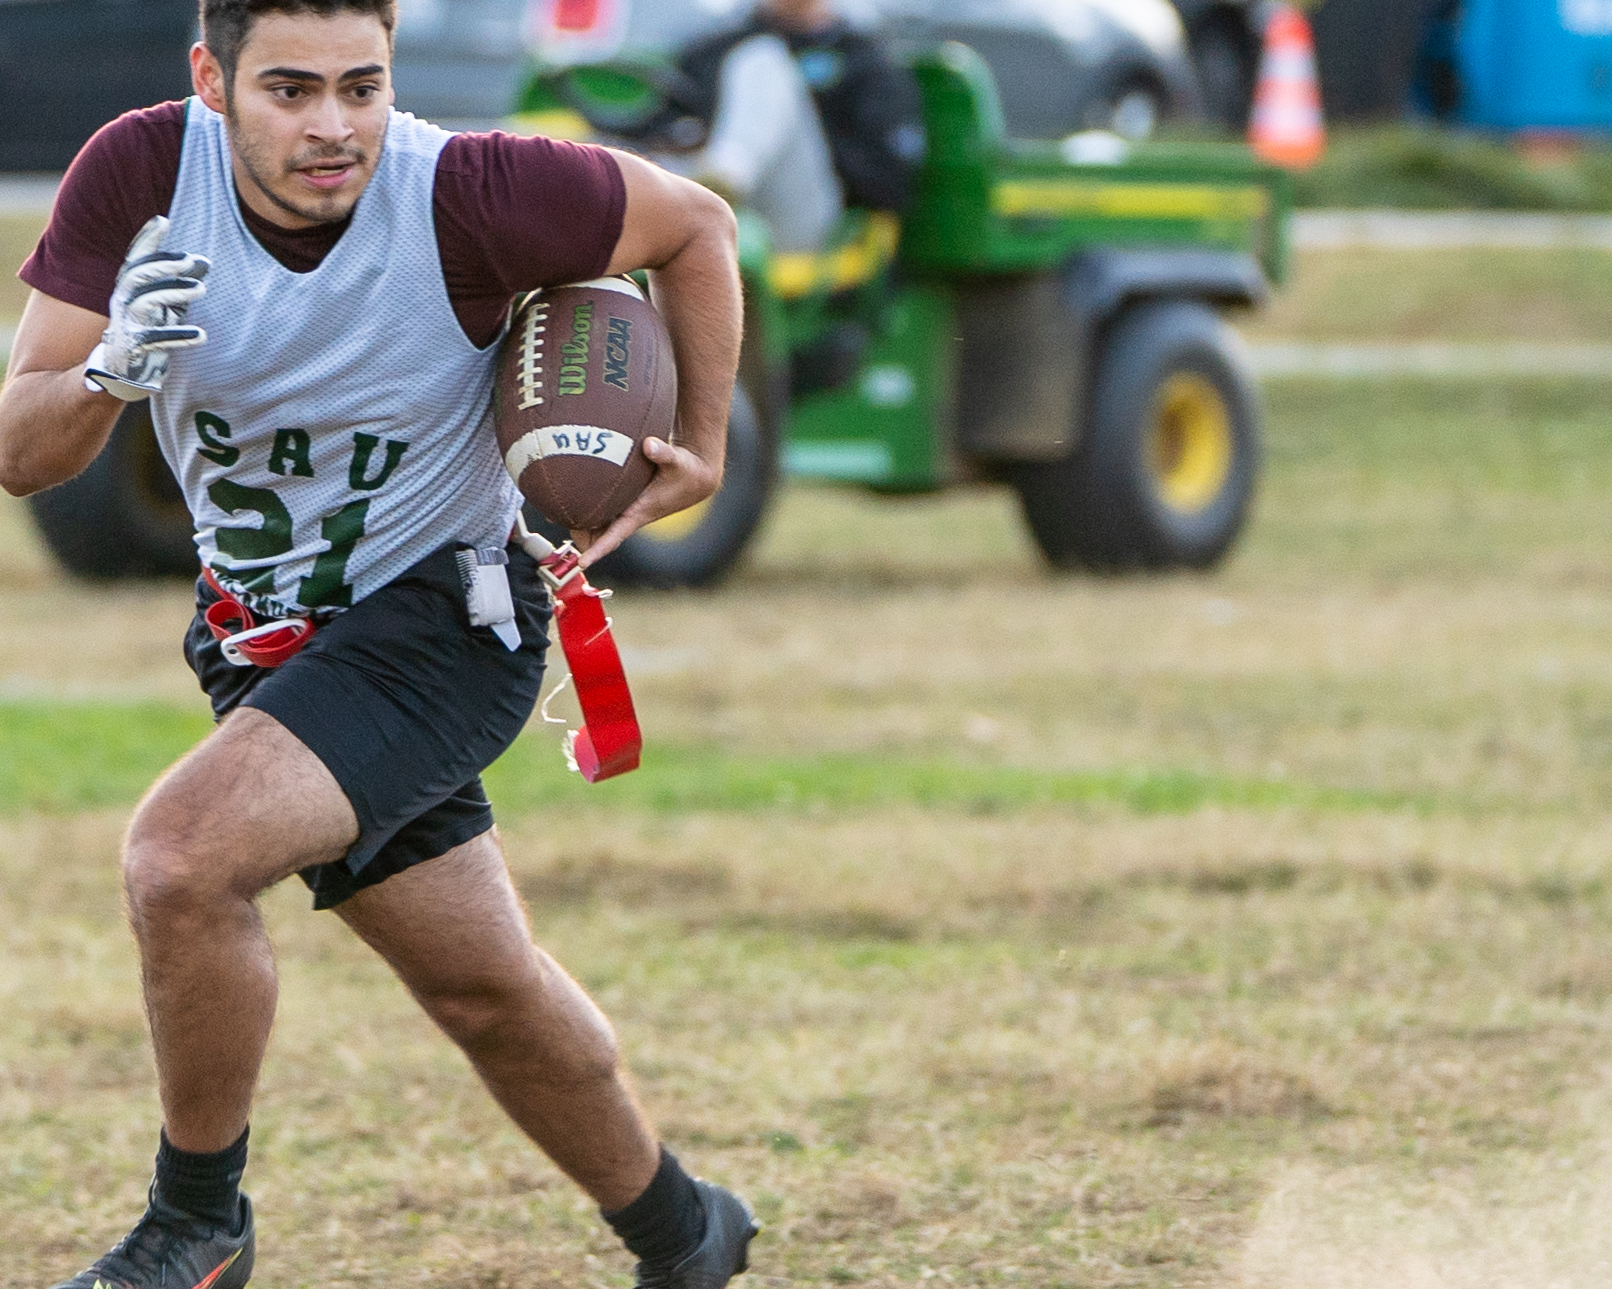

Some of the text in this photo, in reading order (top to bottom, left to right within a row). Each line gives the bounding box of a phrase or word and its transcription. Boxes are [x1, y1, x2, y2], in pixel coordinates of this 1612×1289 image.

[558, 299, 595, 397] Wilson
[603, 315, 633, 392] NCAA
[194, 410, 411, 491] SAU
[207, 477, 371, 608] 21
